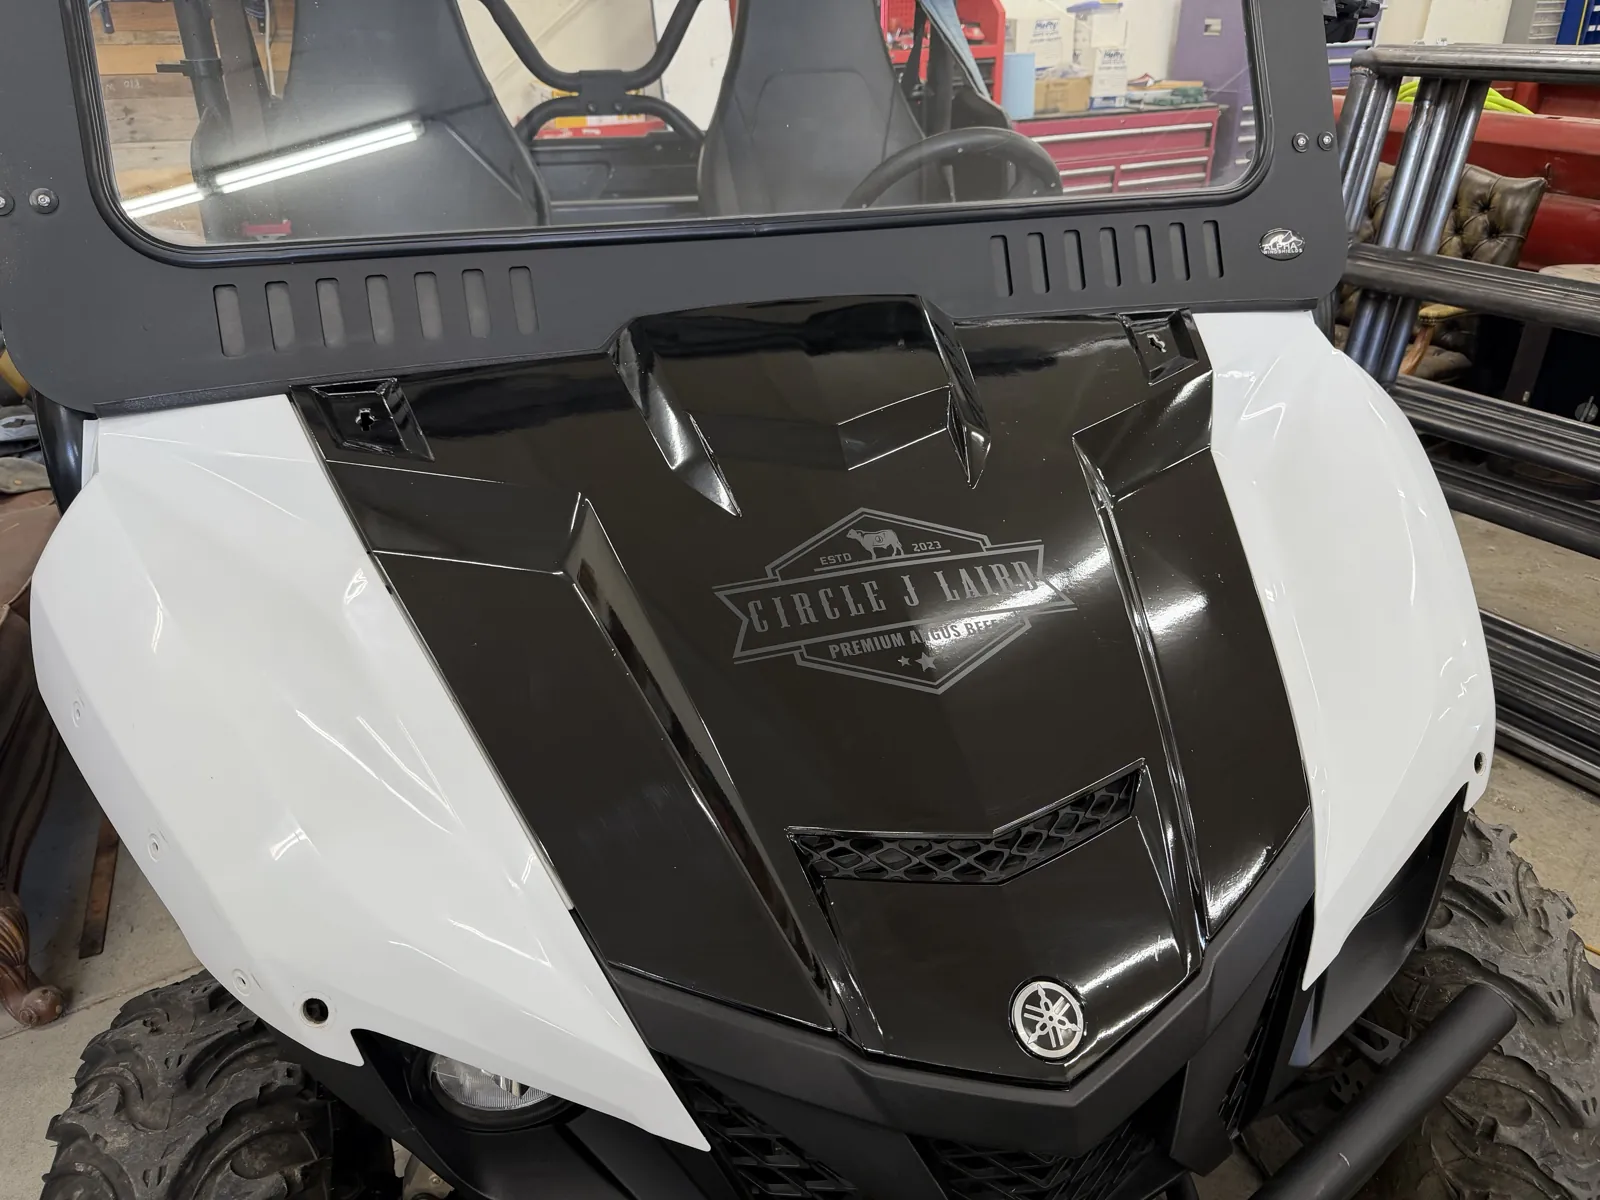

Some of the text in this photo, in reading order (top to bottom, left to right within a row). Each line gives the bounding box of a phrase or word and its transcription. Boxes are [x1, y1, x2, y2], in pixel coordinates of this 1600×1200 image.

[1263, 242, 1298, 251] ALPHA
[819, 540, 942, 566] ESTD 2023
[747, 561, 1039, 633] CIRCLE J LAIRD
[828, 633, 906, 660] PREMIUM
